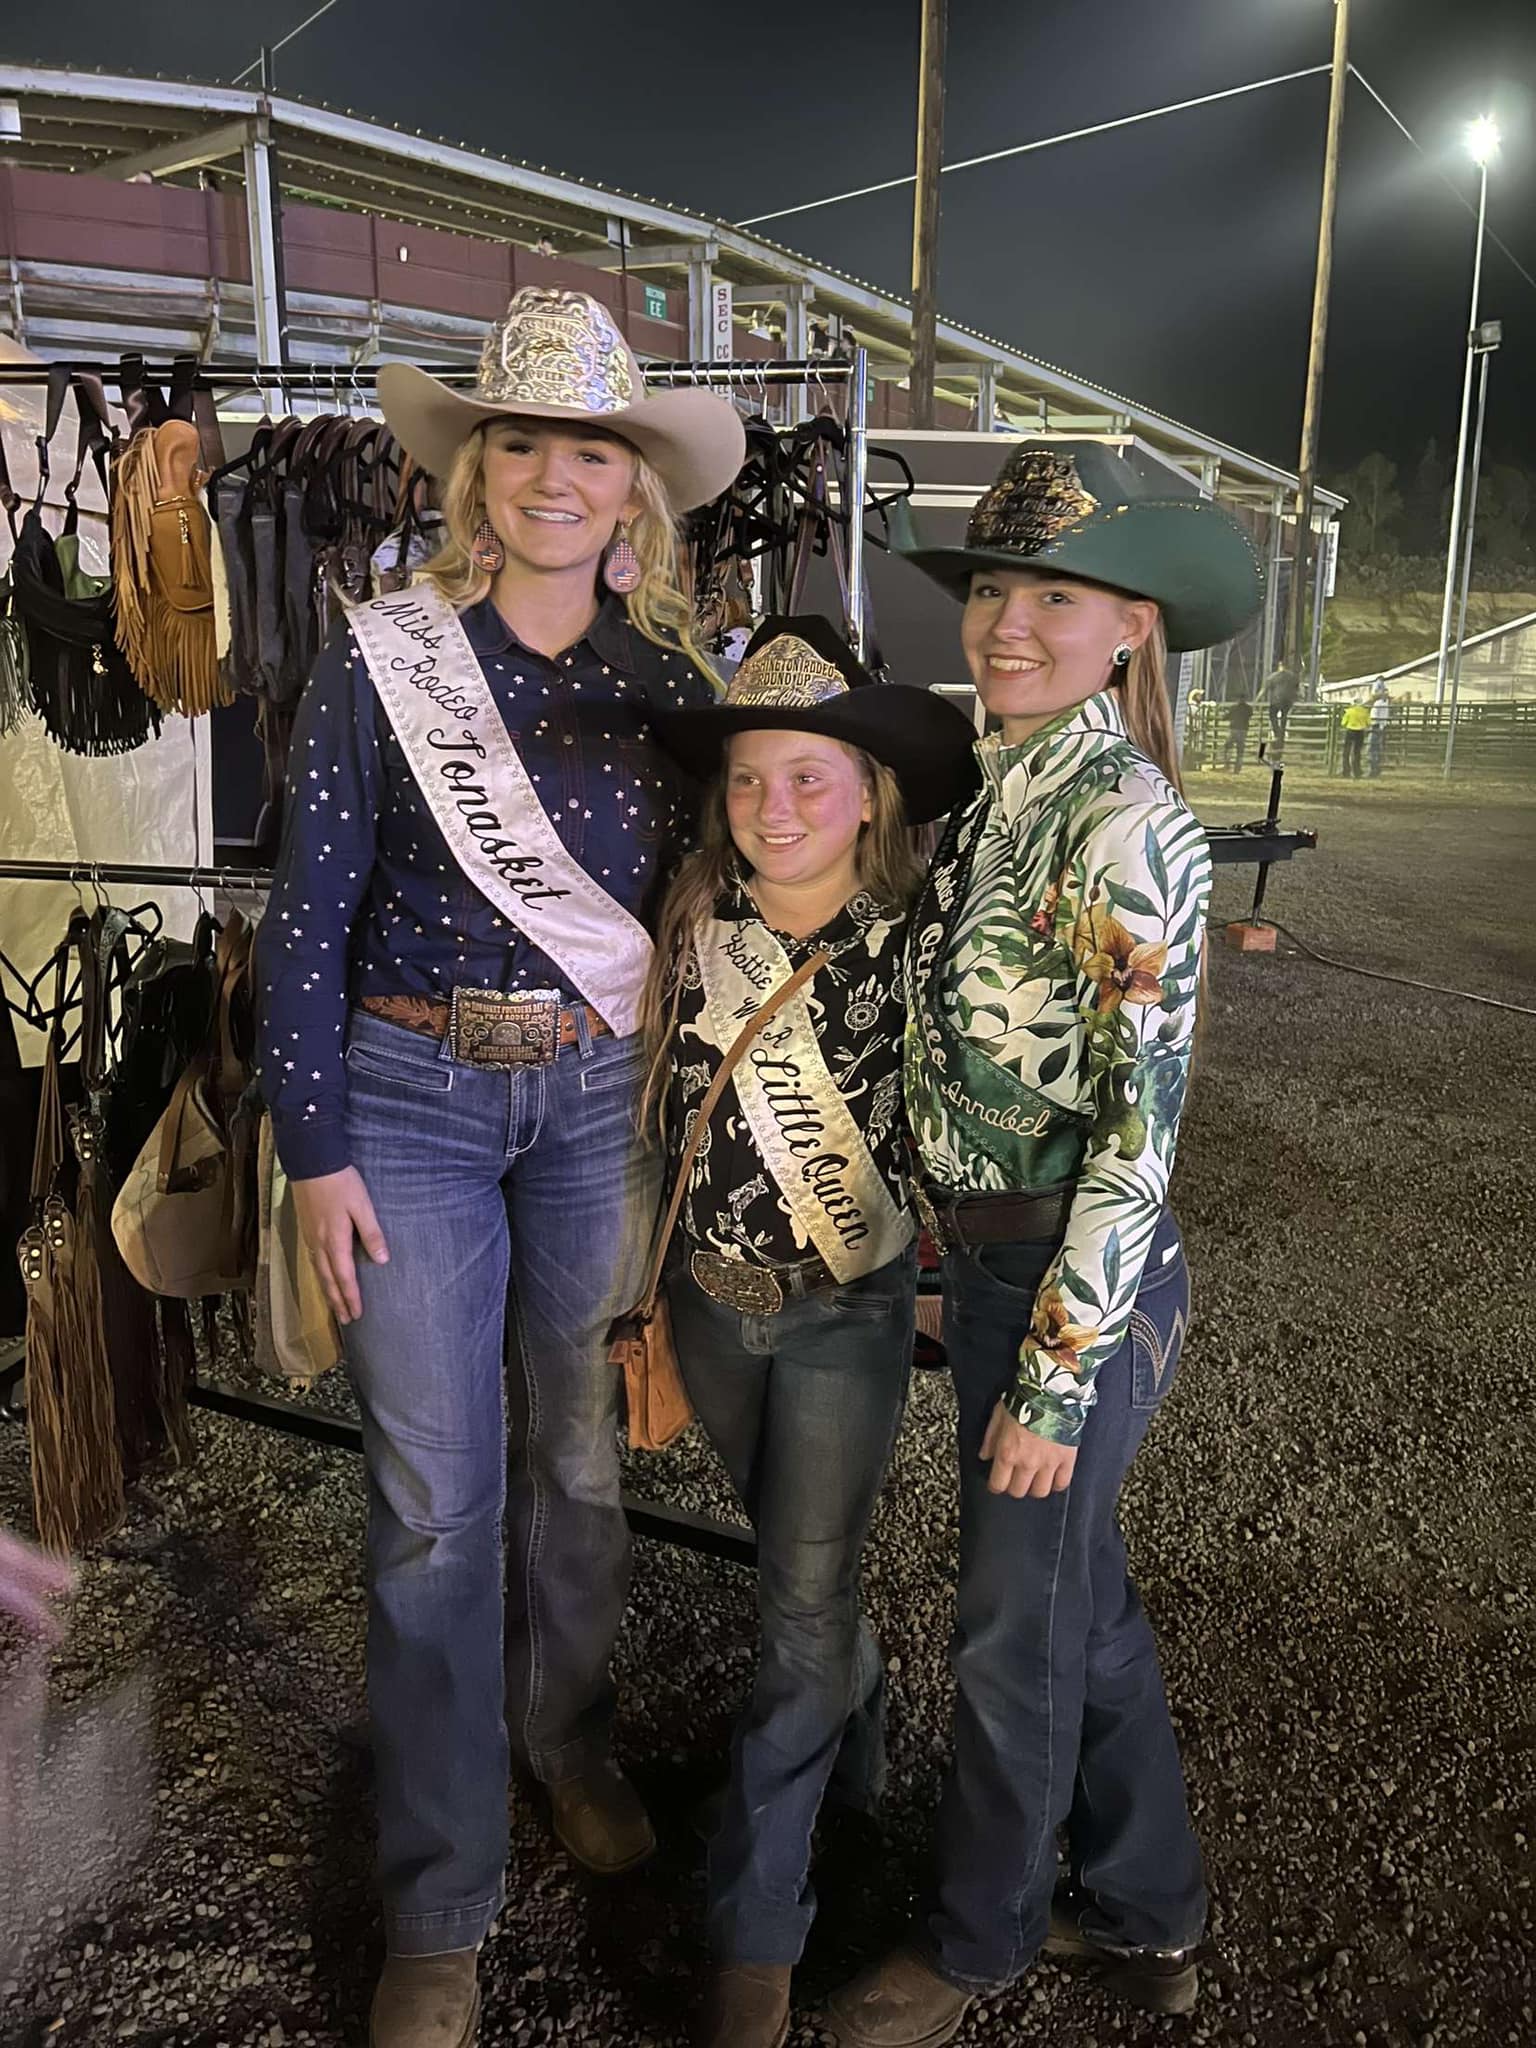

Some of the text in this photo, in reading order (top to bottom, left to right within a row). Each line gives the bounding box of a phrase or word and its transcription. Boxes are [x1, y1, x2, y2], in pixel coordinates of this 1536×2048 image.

[650, 301, 662, 318] EE
[716, 288, 729, 360] SEC CC
[803, 659, 835, 678] RODEO
[370, 599, 572, 911] Miss Rodeo Tonasket
[718, 933, 773, 990] Hattie
[941, 1081, 1050, 1137] Annabel
[750, 1048, 871, 1250] Little Queen
